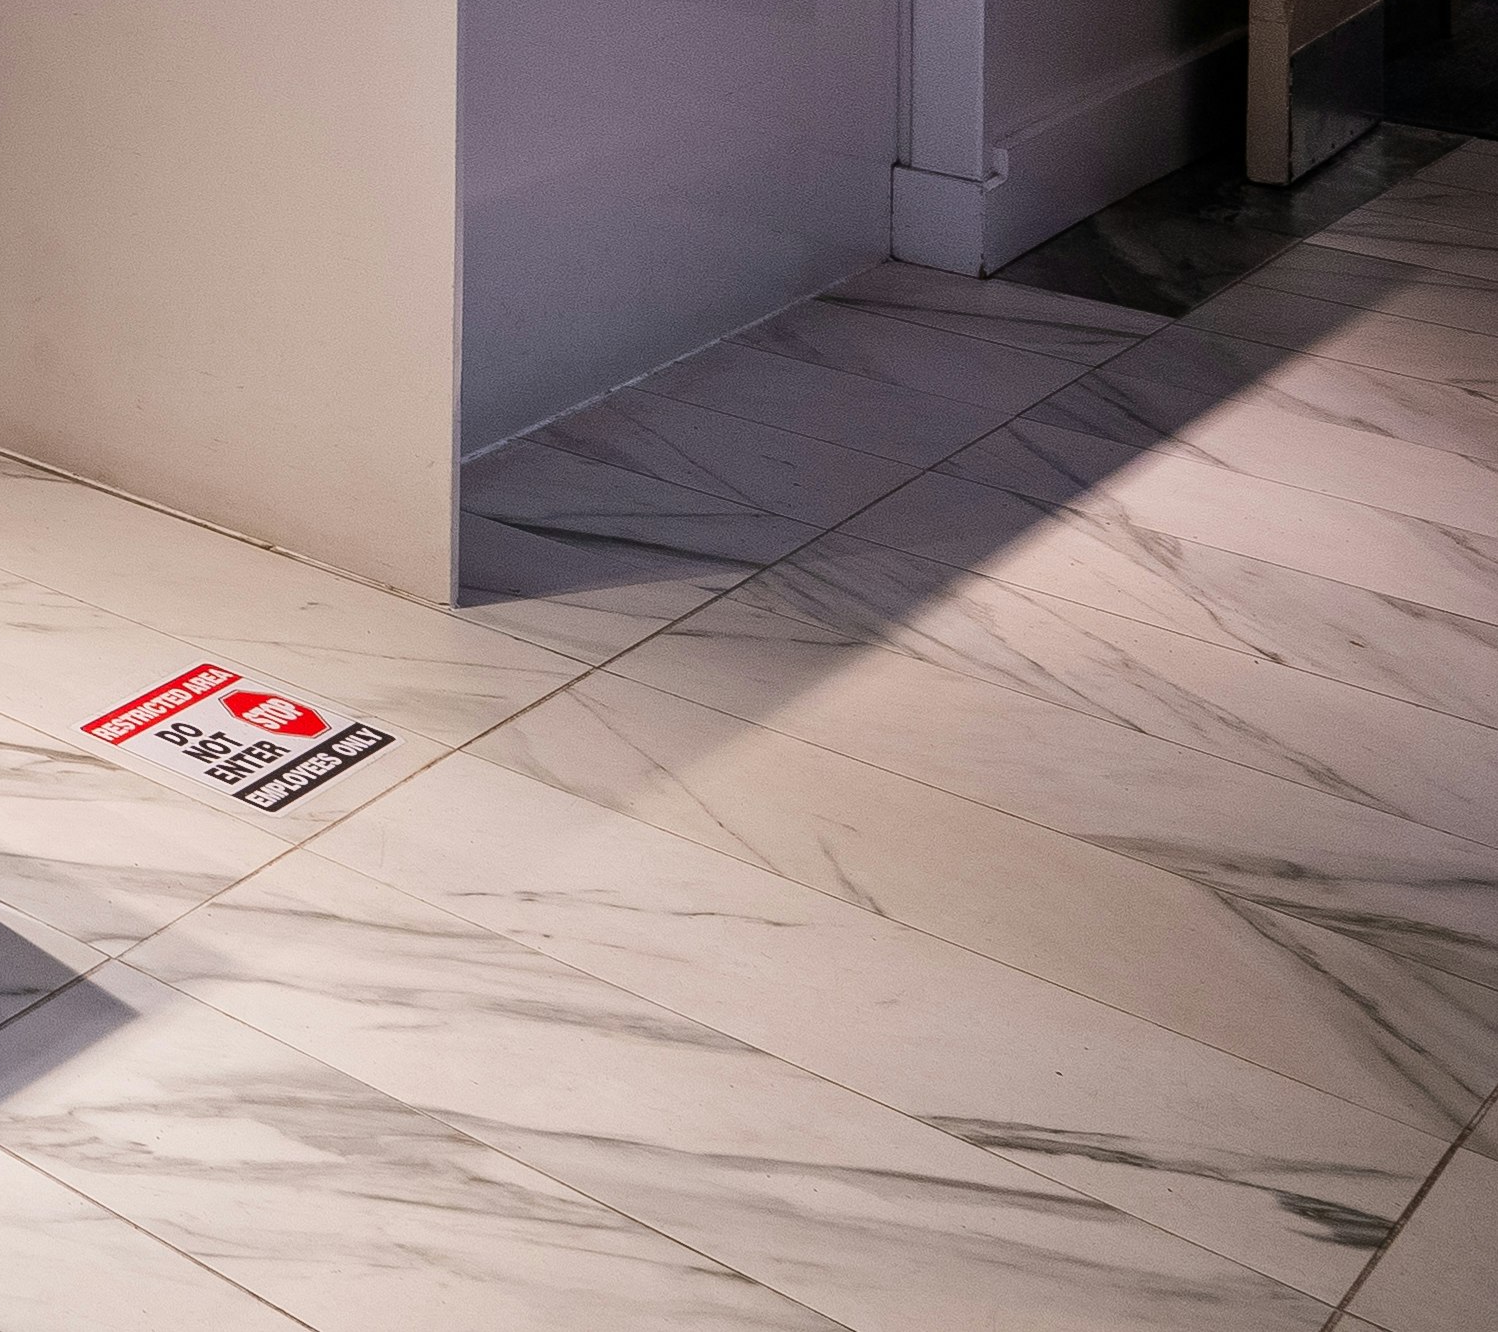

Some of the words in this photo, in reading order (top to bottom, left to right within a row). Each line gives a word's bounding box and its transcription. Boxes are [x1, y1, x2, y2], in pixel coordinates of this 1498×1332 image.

[92, 689, 194, 741] RESTRICTED
[189, 668, 235, 696] AREA
[242, 697, 304, 731] STOP
[153, 722, 204, 747] DO
[182, 731, 244, 765] NOT
[203, 740, 292, 786] ENTER
[244, 752, 344, 809] EMPLOYEES
[331, 727, 384, 757] ONLY
